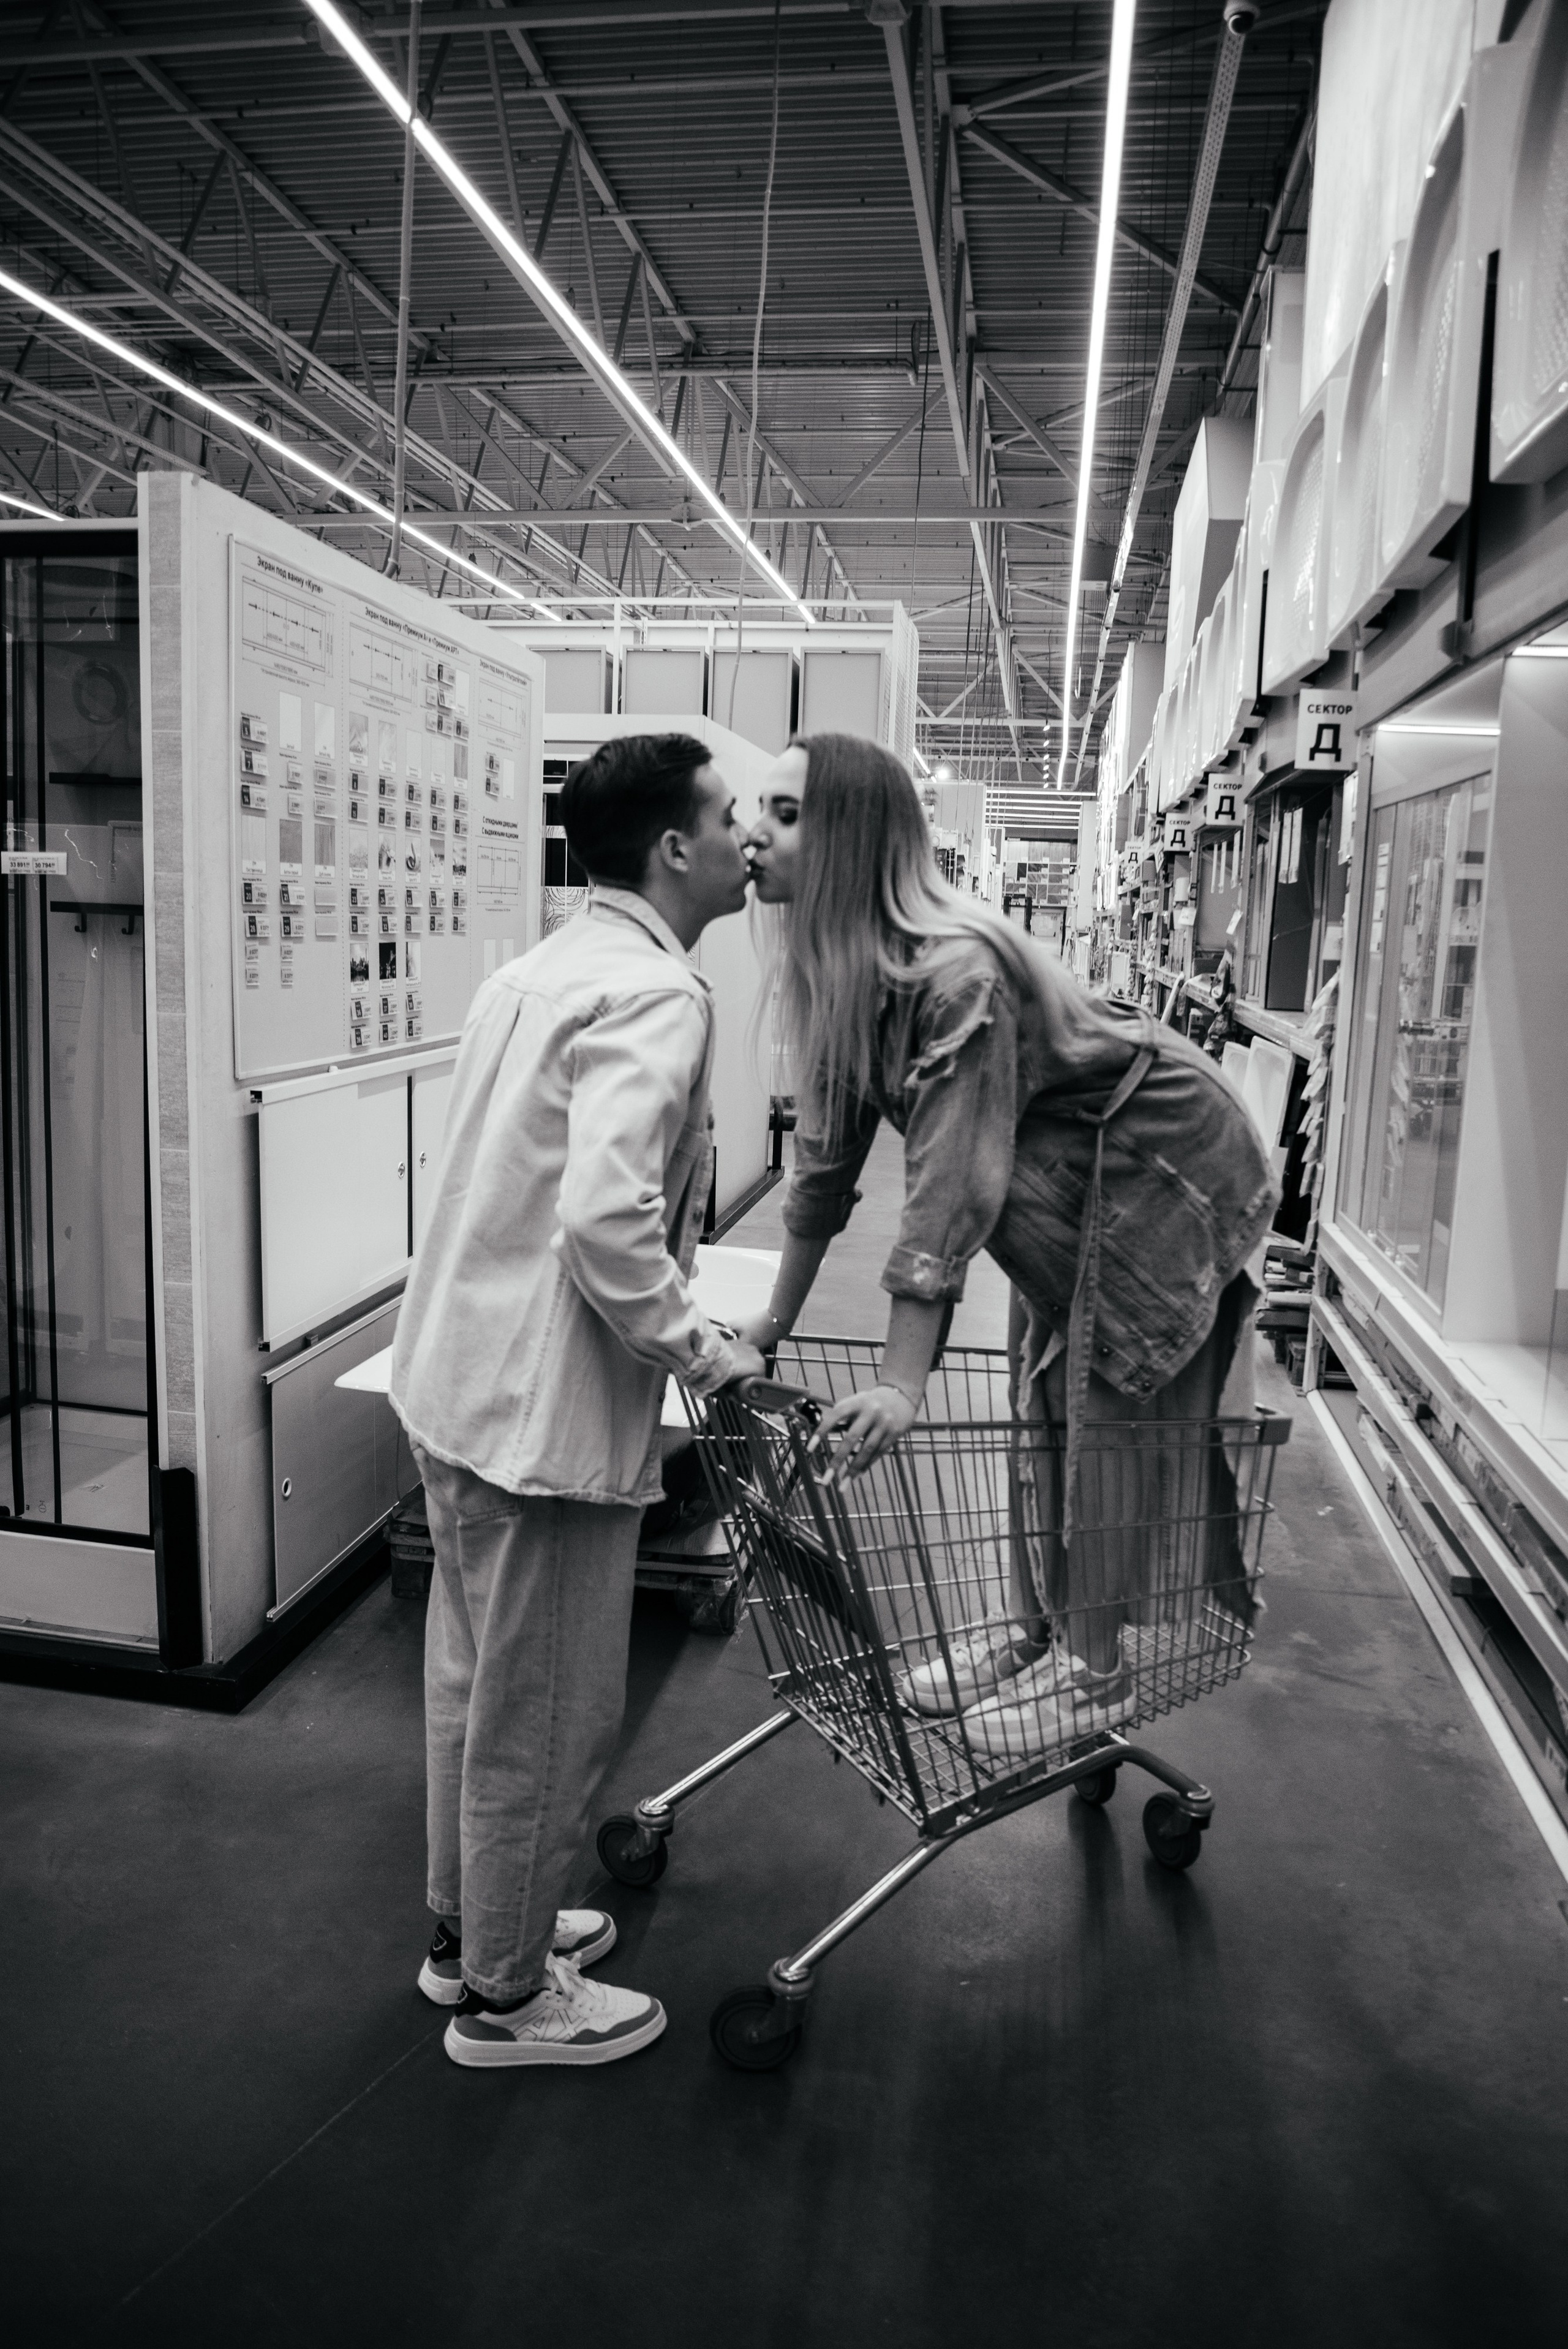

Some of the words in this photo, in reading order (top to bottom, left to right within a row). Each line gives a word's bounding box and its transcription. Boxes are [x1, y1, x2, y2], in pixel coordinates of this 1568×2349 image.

[257, 556, 275, 573] Экран
[276, 567, 287, 581] под
[287, 572, 304, 588] ванну
[305, 579, 323, 594] «Купе»
[365, 606, 379, 620] Экран
[379, 613, 388, 627] под
[388, 617, 402, 632] ванну
[1307, 703, 1353, 715] СЕКТОР
[1309, 723, 1341, 763] Д
[1215, 795, 1236, 821] Д
[1170, 829, 1186, 848] Д
[1128, 852, 1138, 864] Д
